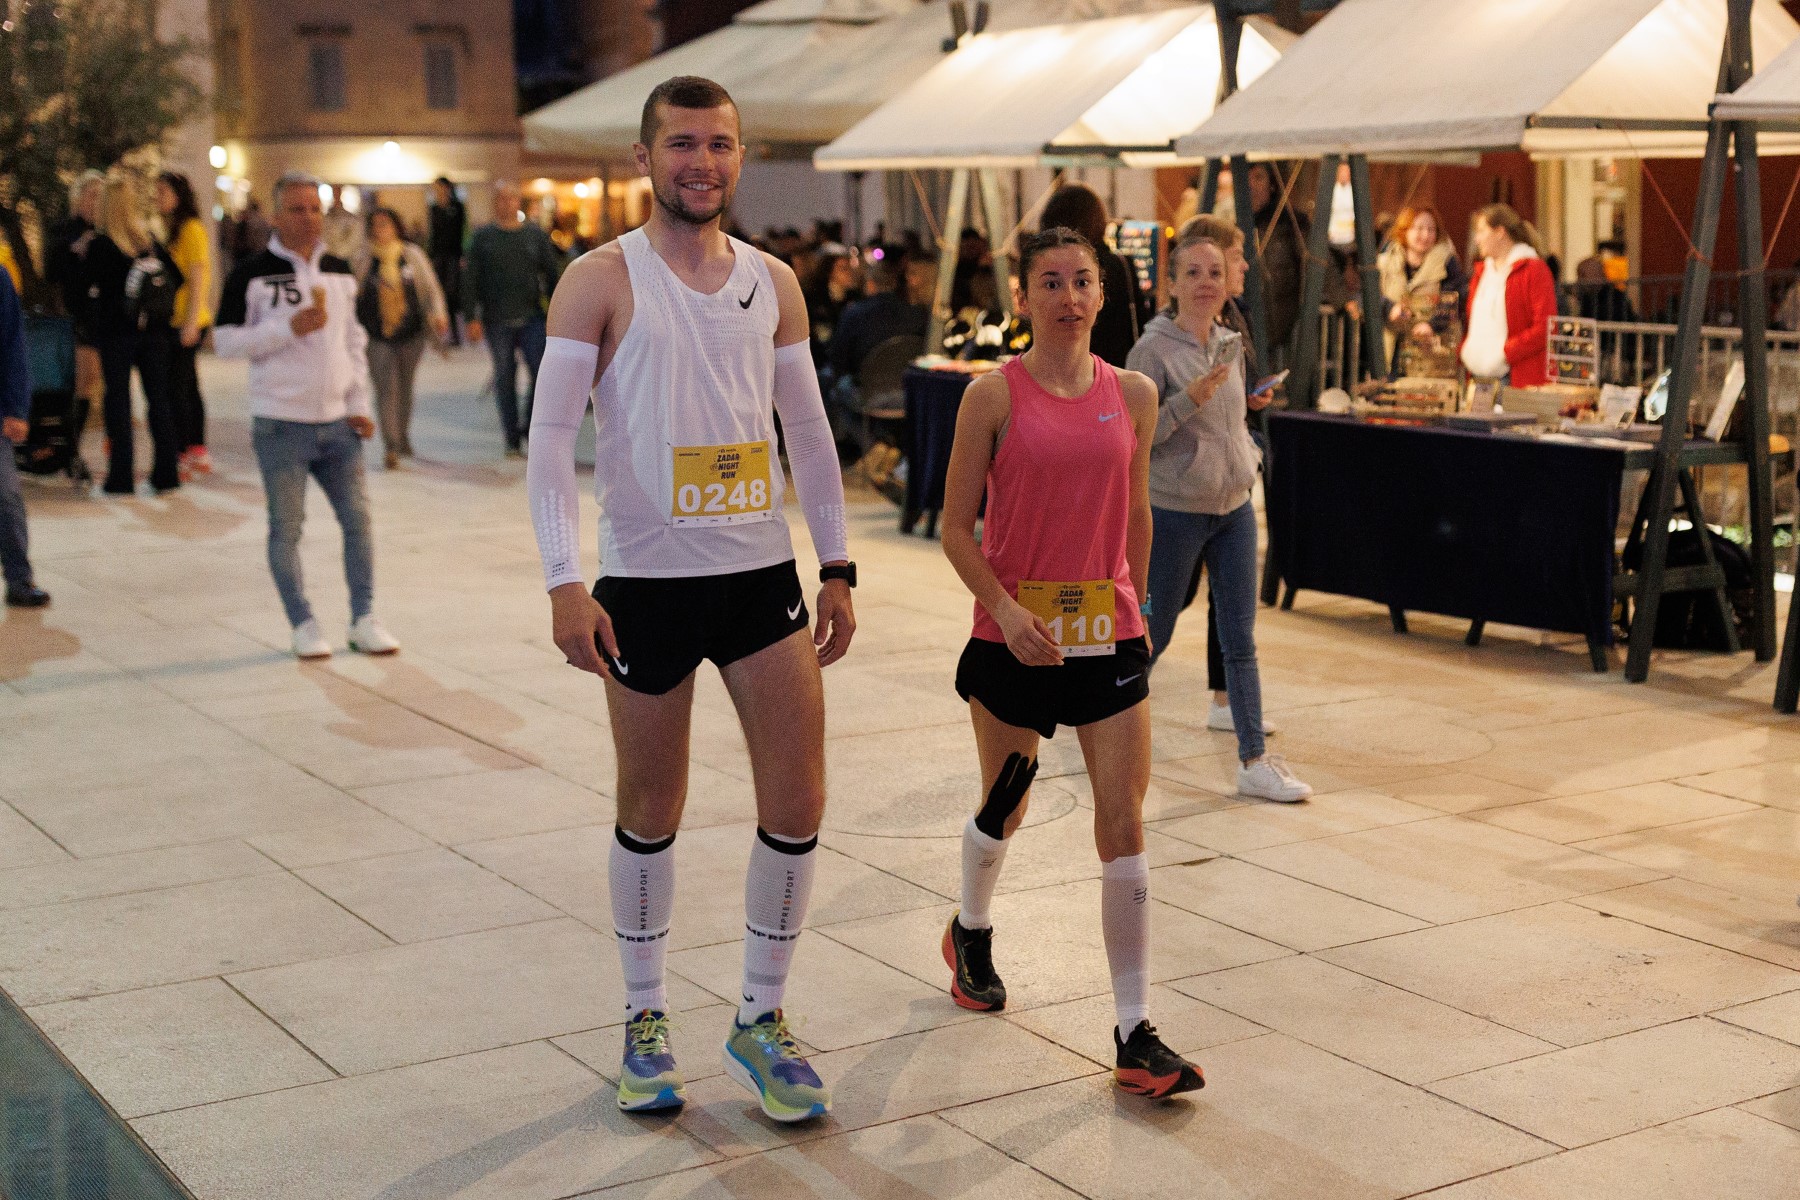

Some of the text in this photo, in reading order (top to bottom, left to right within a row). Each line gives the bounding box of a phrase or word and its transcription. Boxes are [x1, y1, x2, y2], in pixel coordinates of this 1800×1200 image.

[265, 279, 302, 309] 75
[717, 453, 740, 462] ZADAR
[718, 462, 739, 471] NIGHT
[721, 471, 736, 479] RUN
[678, 479, 767, 513] 0248
